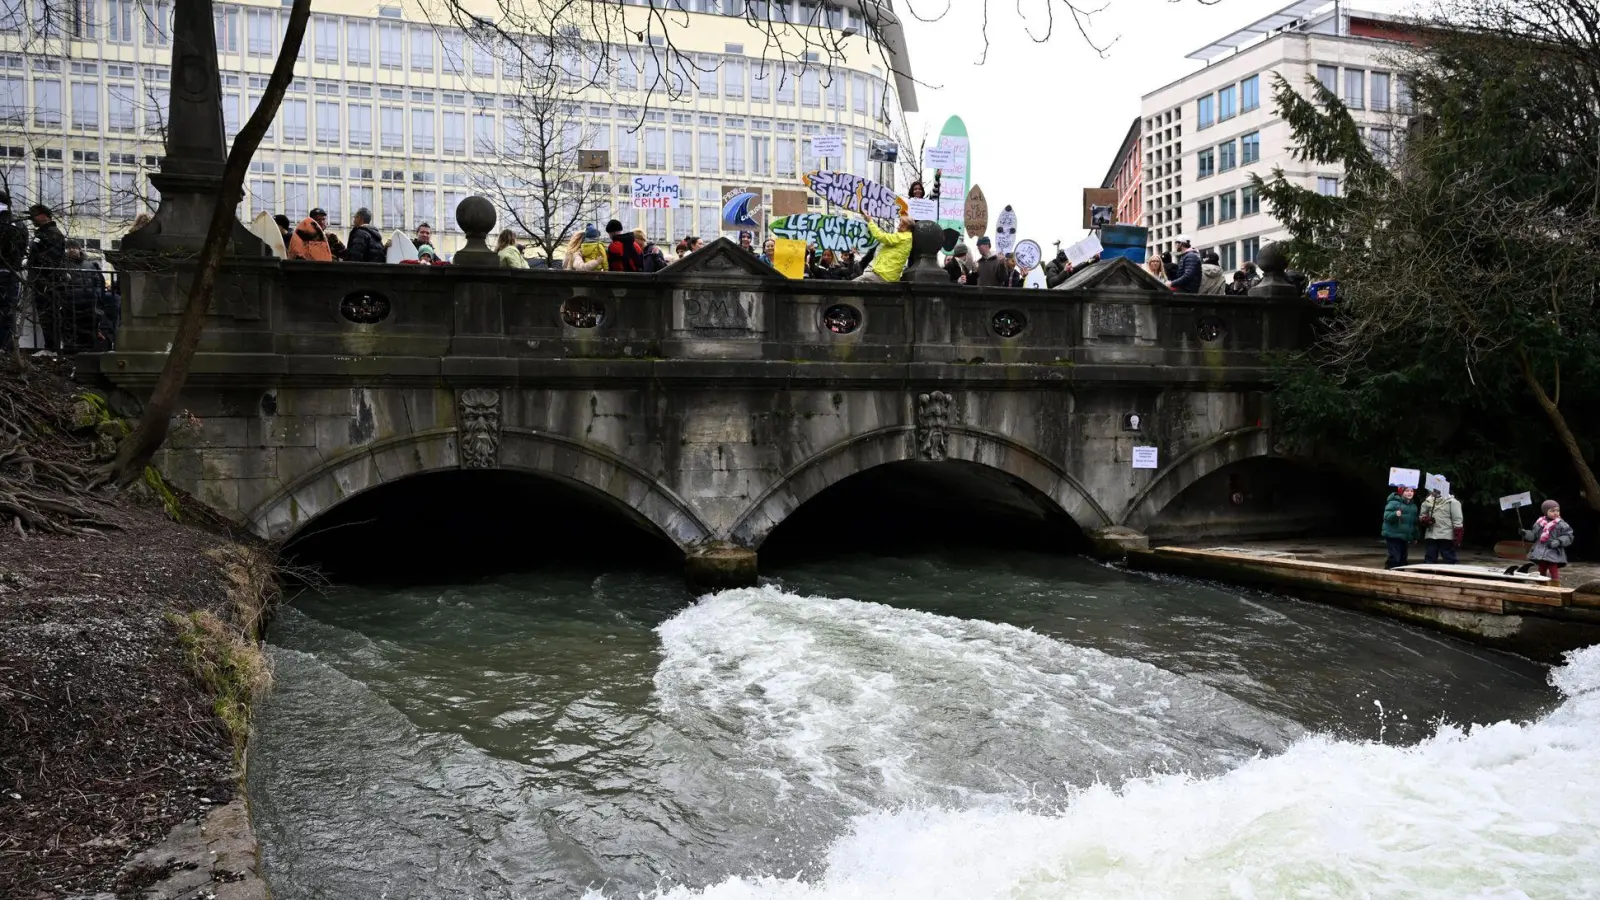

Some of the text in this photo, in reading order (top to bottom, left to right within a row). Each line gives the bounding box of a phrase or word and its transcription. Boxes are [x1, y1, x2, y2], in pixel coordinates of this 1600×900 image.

[634, 177, 679, 199] Surfing
[828, 186, 851, 205] NOT
[848, 195, 858, 211] A
[634, 197, 670, 208] CRIME
[787, 213, 821, 230] LET
[825, 215, 845, 235] US
[966, 210, 986, 220] SURF
[773, 228, 818, 248] THE
